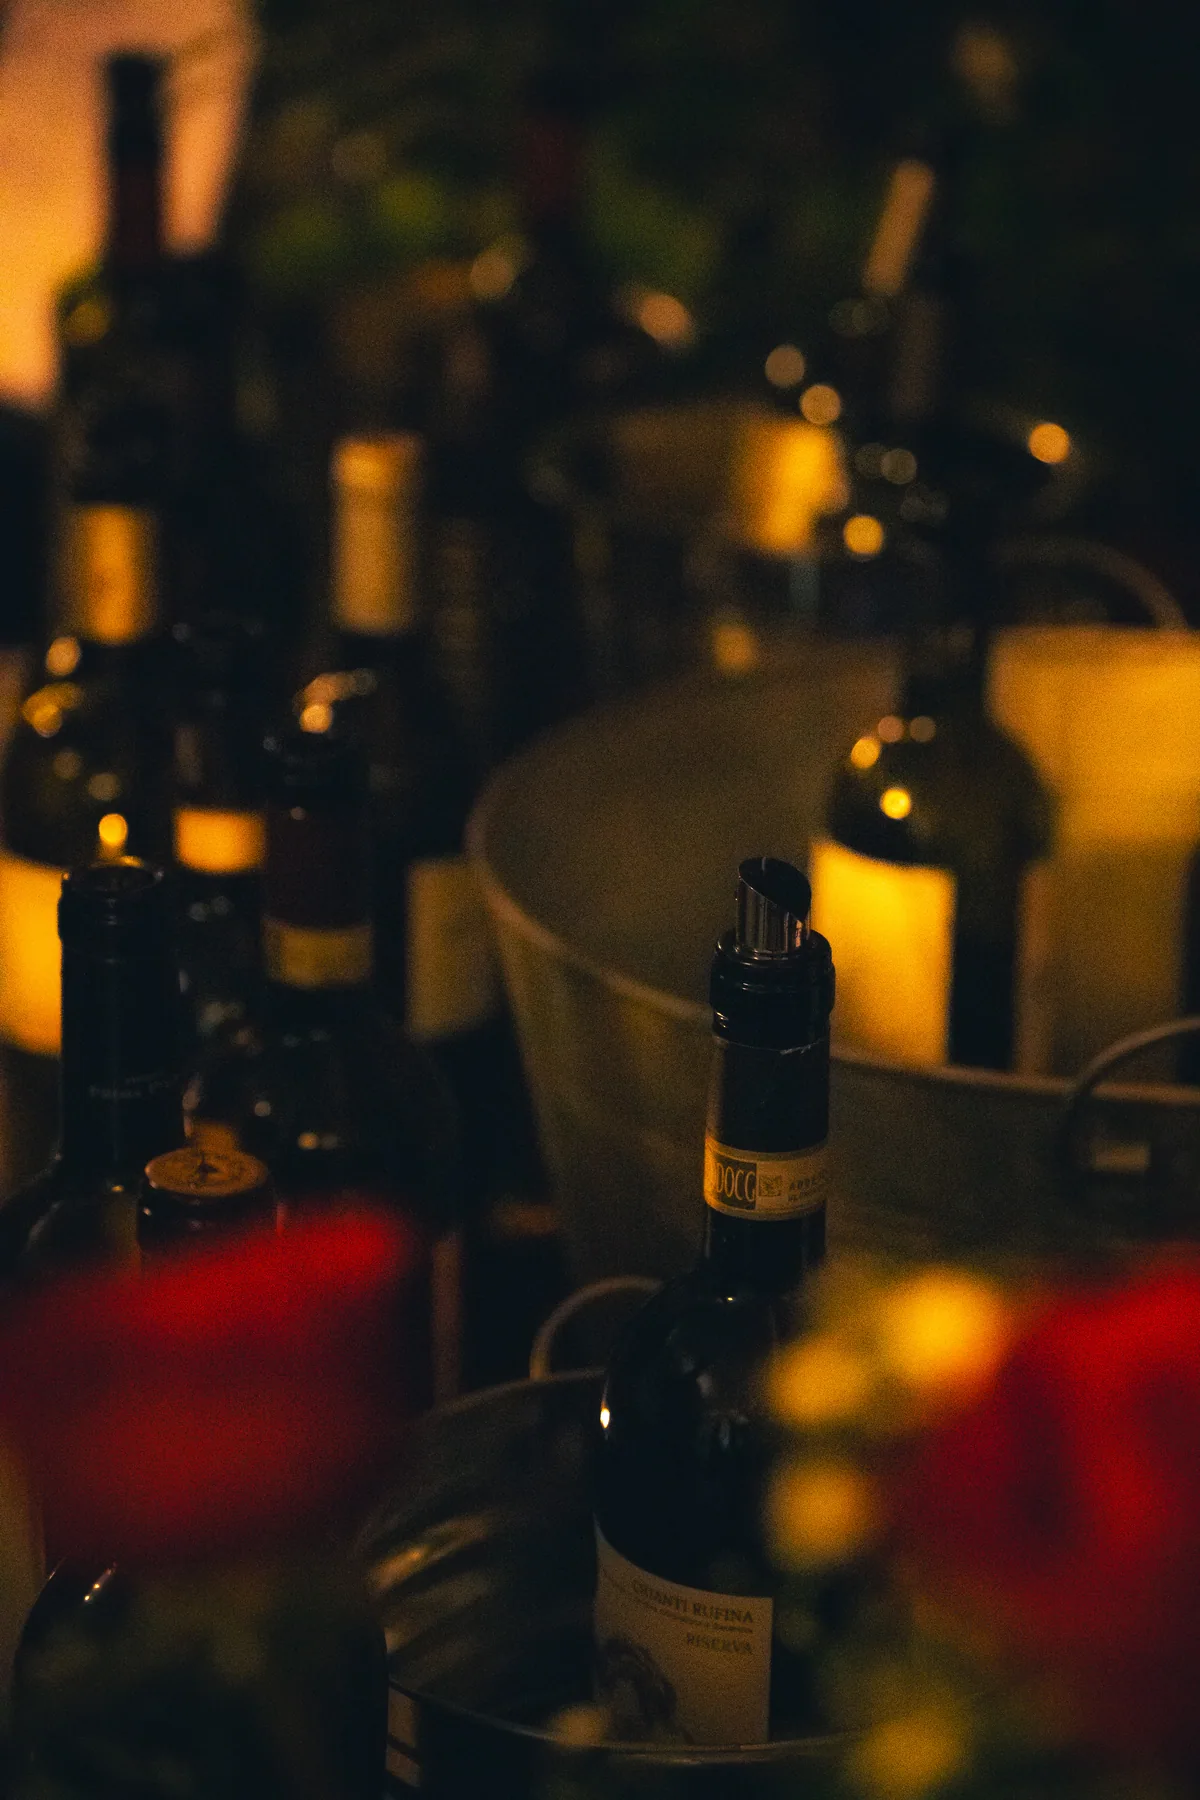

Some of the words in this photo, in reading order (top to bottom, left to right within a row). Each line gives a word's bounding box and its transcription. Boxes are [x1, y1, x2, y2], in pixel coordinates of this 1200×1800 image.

[716, 1162, 756, 1202] DOCG
[693, 1602, 755, 1624] RUFINA
[686, 1632, 754, 1655] RISERVA
